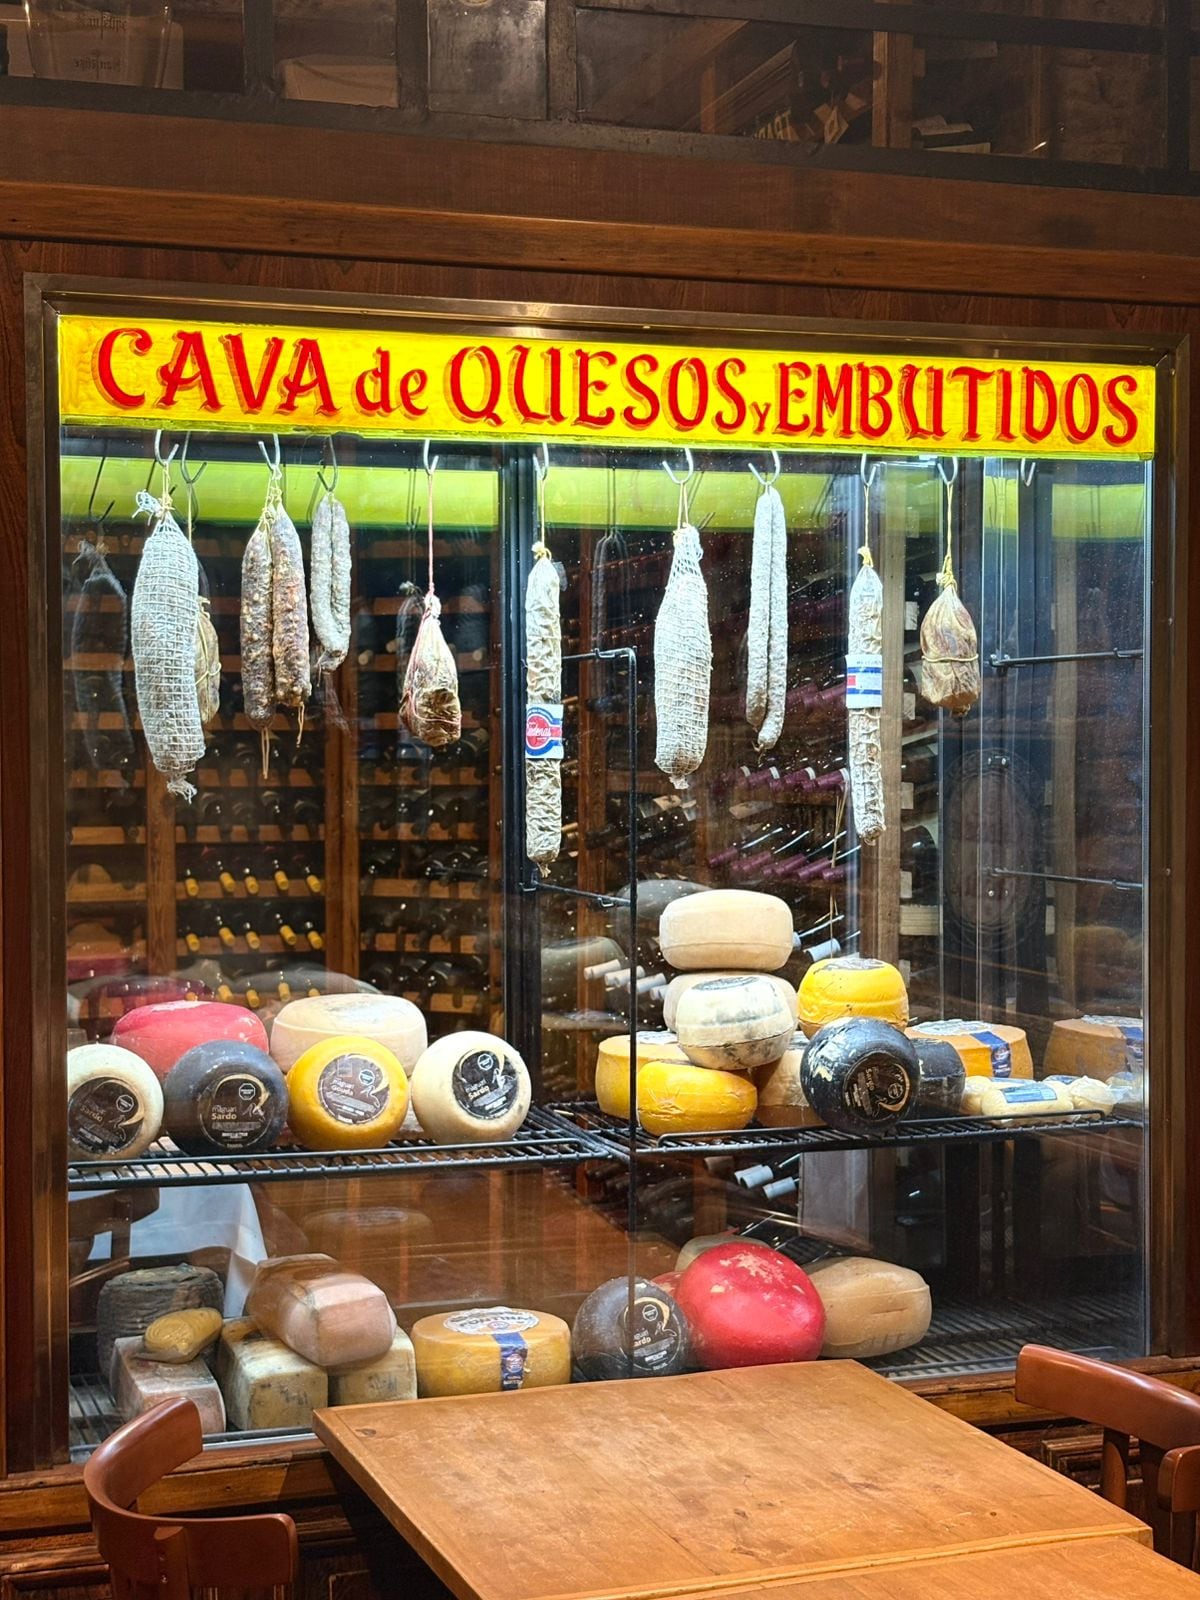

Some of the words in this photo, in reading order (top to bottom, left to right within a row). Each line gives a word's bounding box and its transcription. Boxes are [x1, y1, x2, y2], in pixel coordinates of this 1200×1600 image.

[94, 328, 342, 416] CAVA
[354, 346, 429, 416] de
[446, 344, 748, 433] QUESOS
[773, 361, 1141, 447] EMBUTIDOS
[80, 1105, 103, 1122] Sardo
[211, 1112, 237, 1120] Sardo
